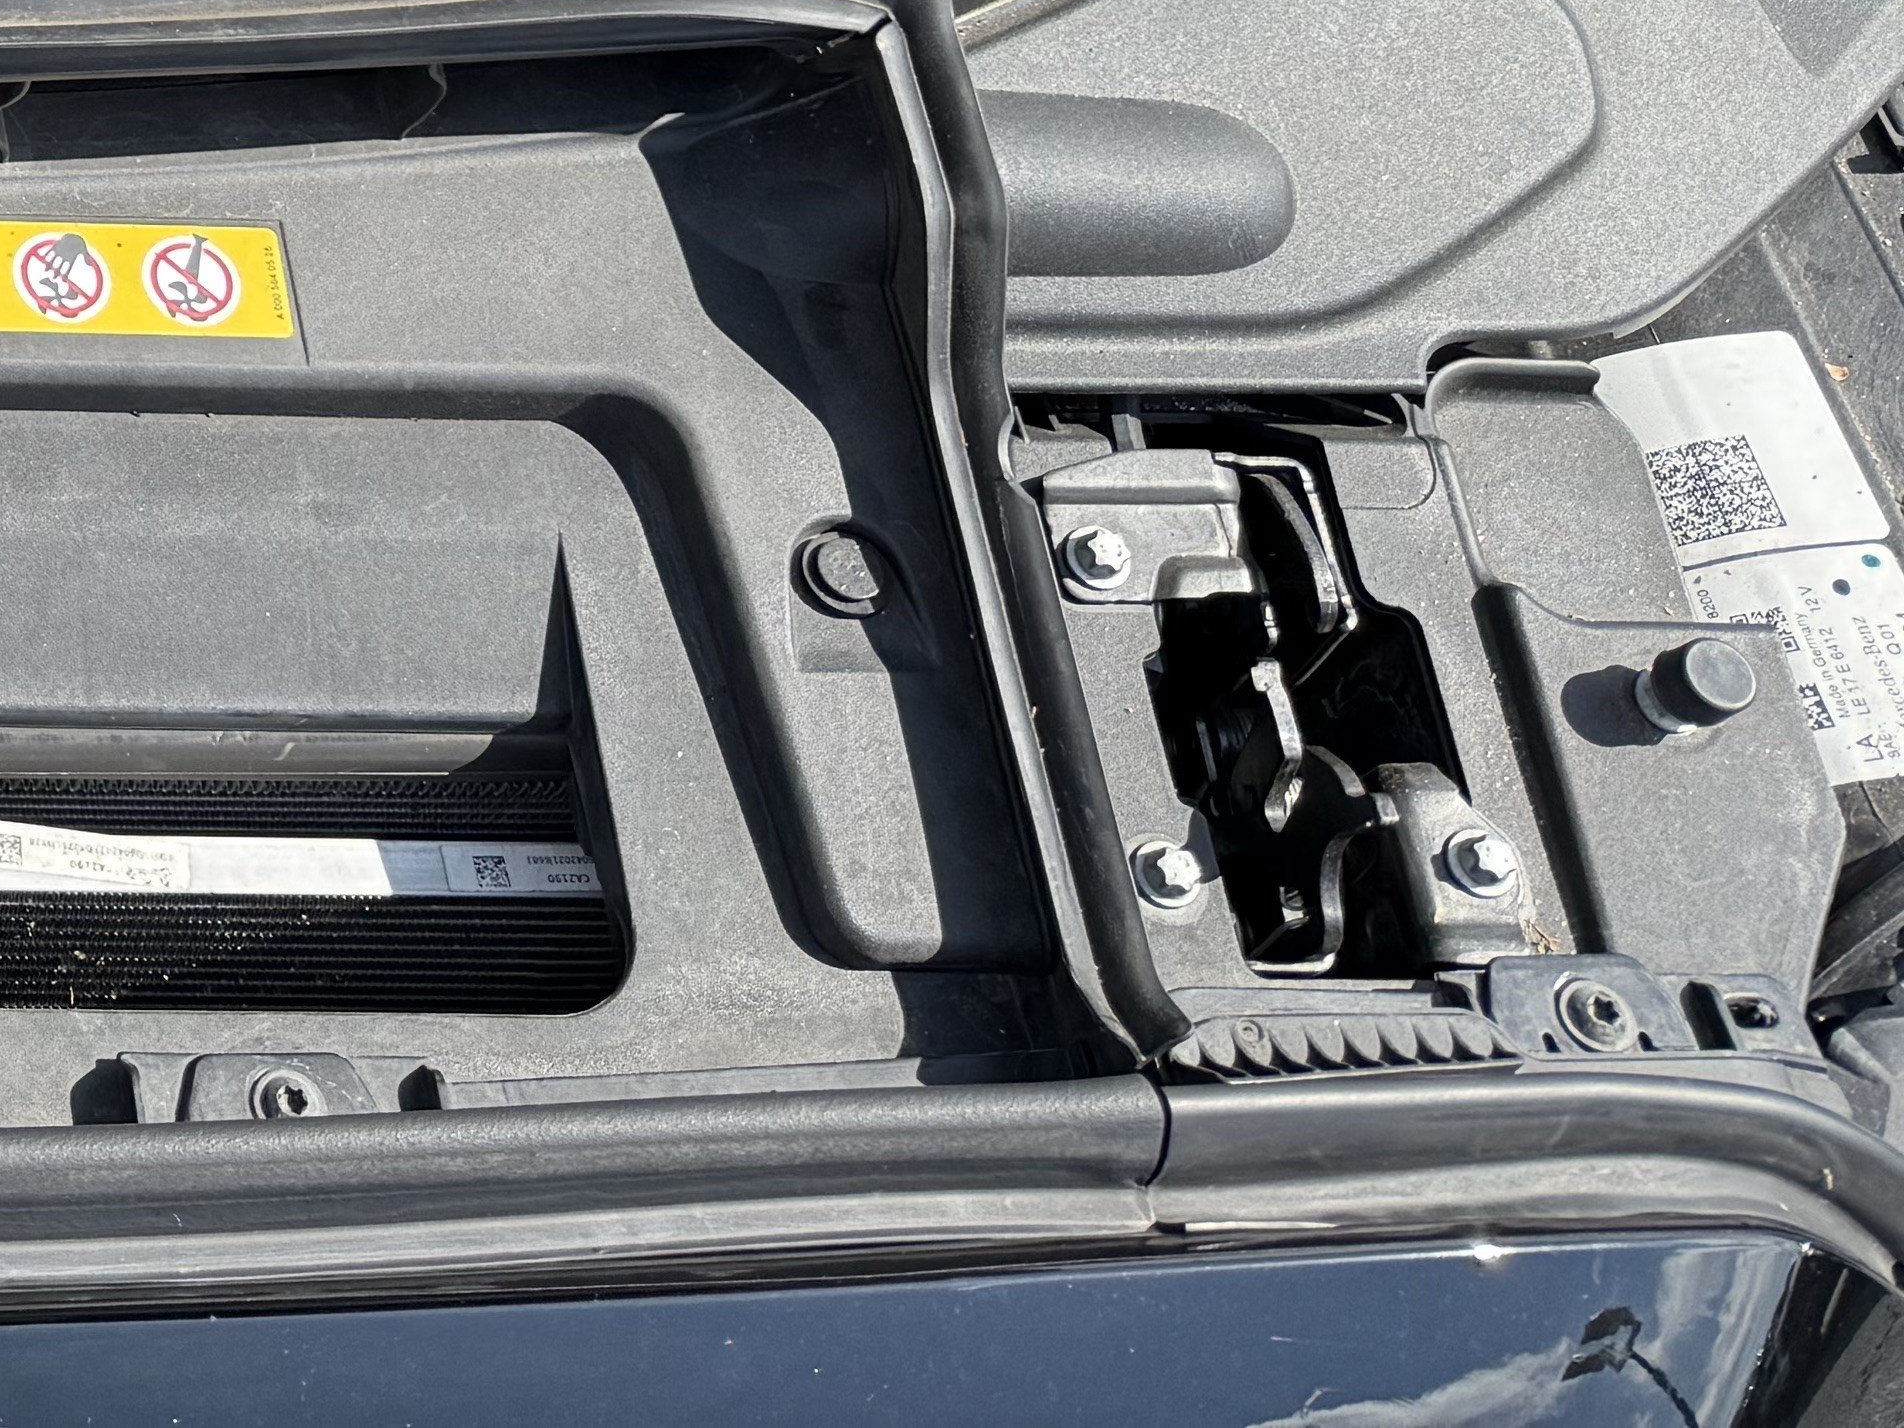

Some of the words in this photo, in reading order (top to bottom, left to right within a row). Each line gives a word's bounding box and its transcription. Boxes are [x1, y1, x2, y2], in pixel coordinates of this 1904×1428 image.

[1696, 588, 1720, 620] 8200
[1794, 611, 1828, 669] Germany
[1818, 626, 1846, 661] 6412
[1827, 682, 1852, 720] Made
[1855, 732, 1885, 763] LA
[547, 873, 591, 884] CA2190
